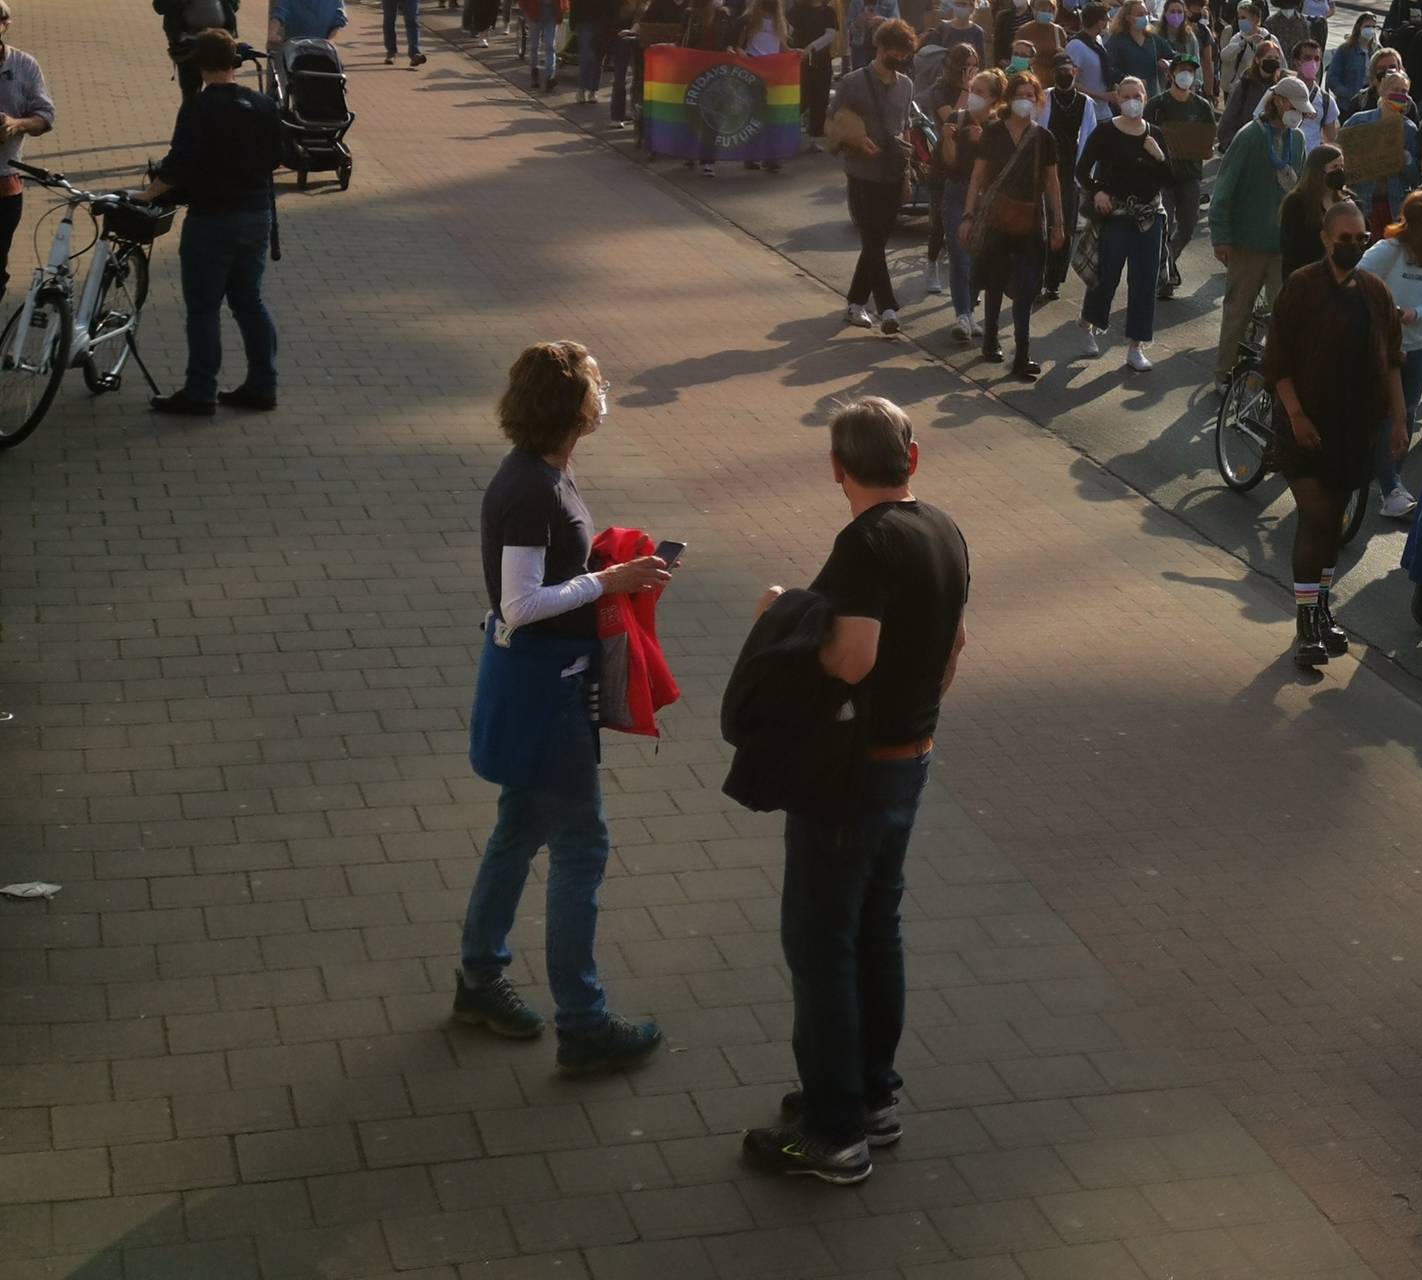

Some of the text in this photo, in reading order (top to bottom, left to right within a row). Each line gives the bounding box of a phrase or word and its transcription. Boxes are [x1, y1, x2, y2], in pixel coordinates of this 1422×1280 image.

[687, 65, 757, 106] FRIDAYS FOR
[714, 116, 762, 147] FUTURE
